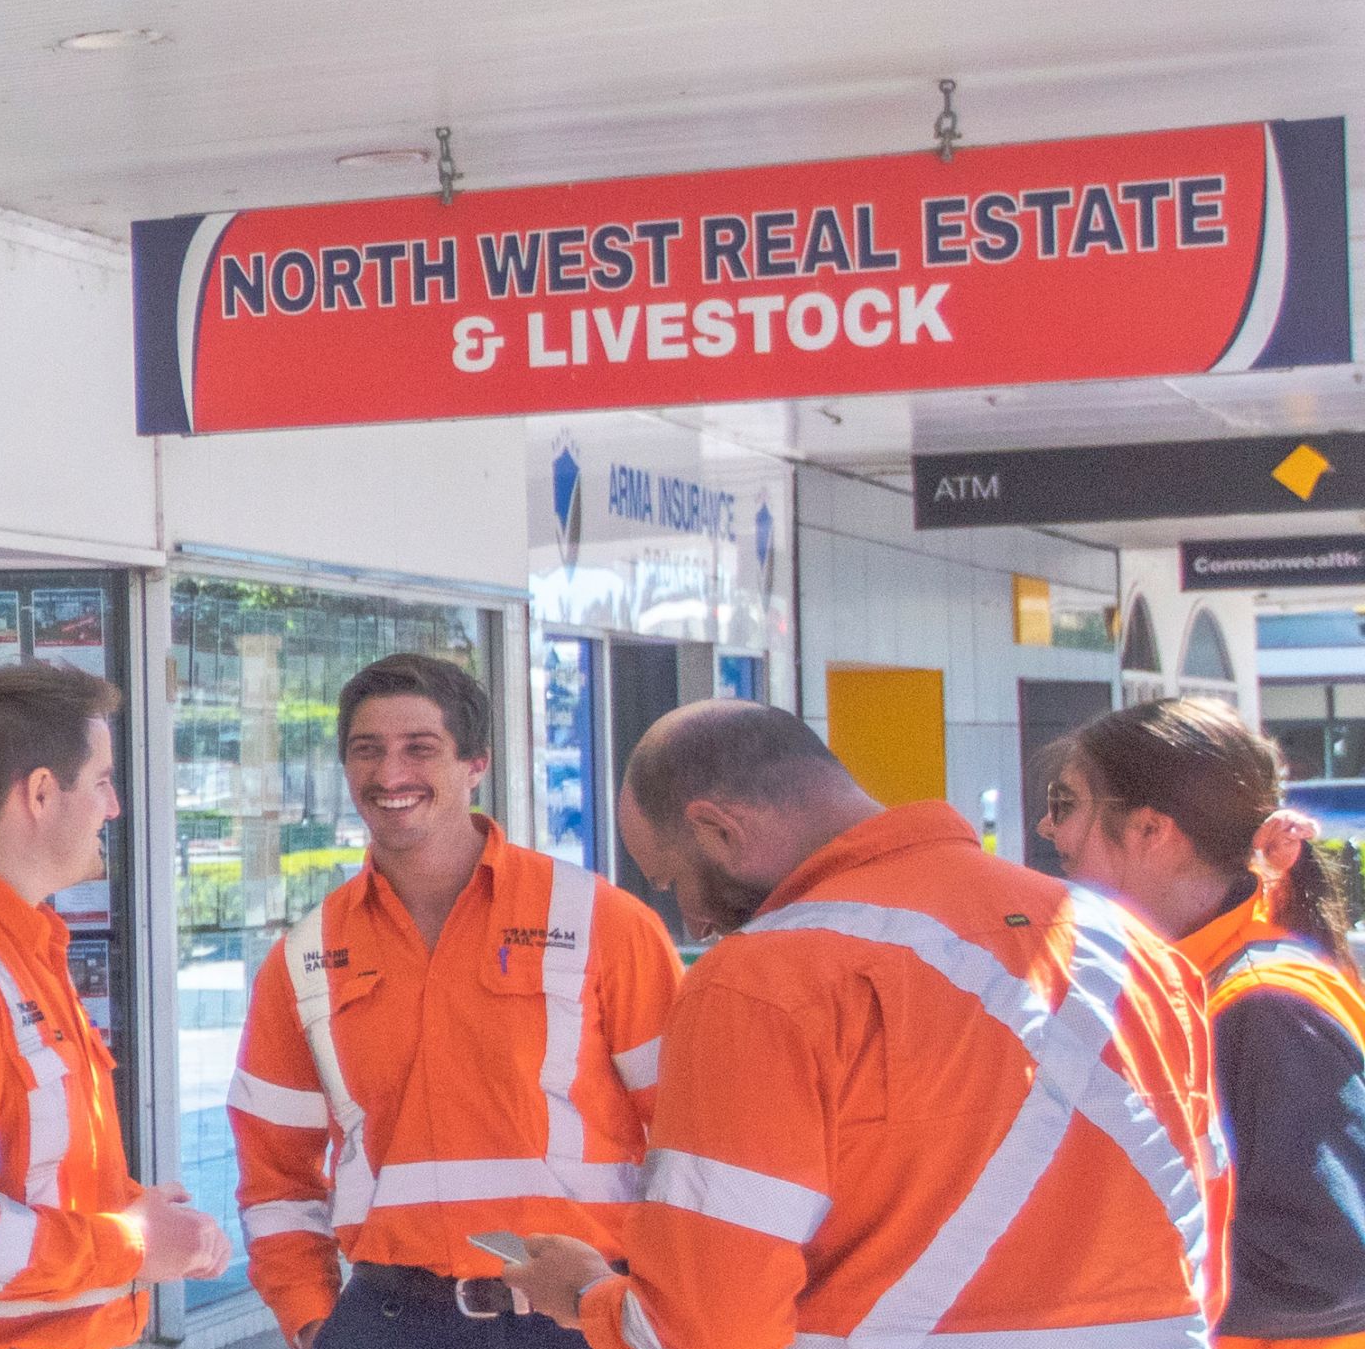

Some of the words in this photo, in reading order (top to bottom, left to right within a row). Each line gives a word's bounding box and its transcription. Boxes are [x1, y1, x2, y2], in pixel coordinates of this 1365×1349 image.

[220, 236, 459, 319] NORTH
[477, 218, 683, 299] WEST
[701, 203, 901, 283] REAL
[922, 174, 1229, 267] ESTATE
[451, 315, 506, 373] &
[527, 282, 955, 369] LIVESTOCK
[608, 462, 653, 525] ARMA
[658, 475, 737, 543] INSURANCE
[933, 474, 999, 503] ATM
[1193, 552, 1361, 574] Commonwealth
